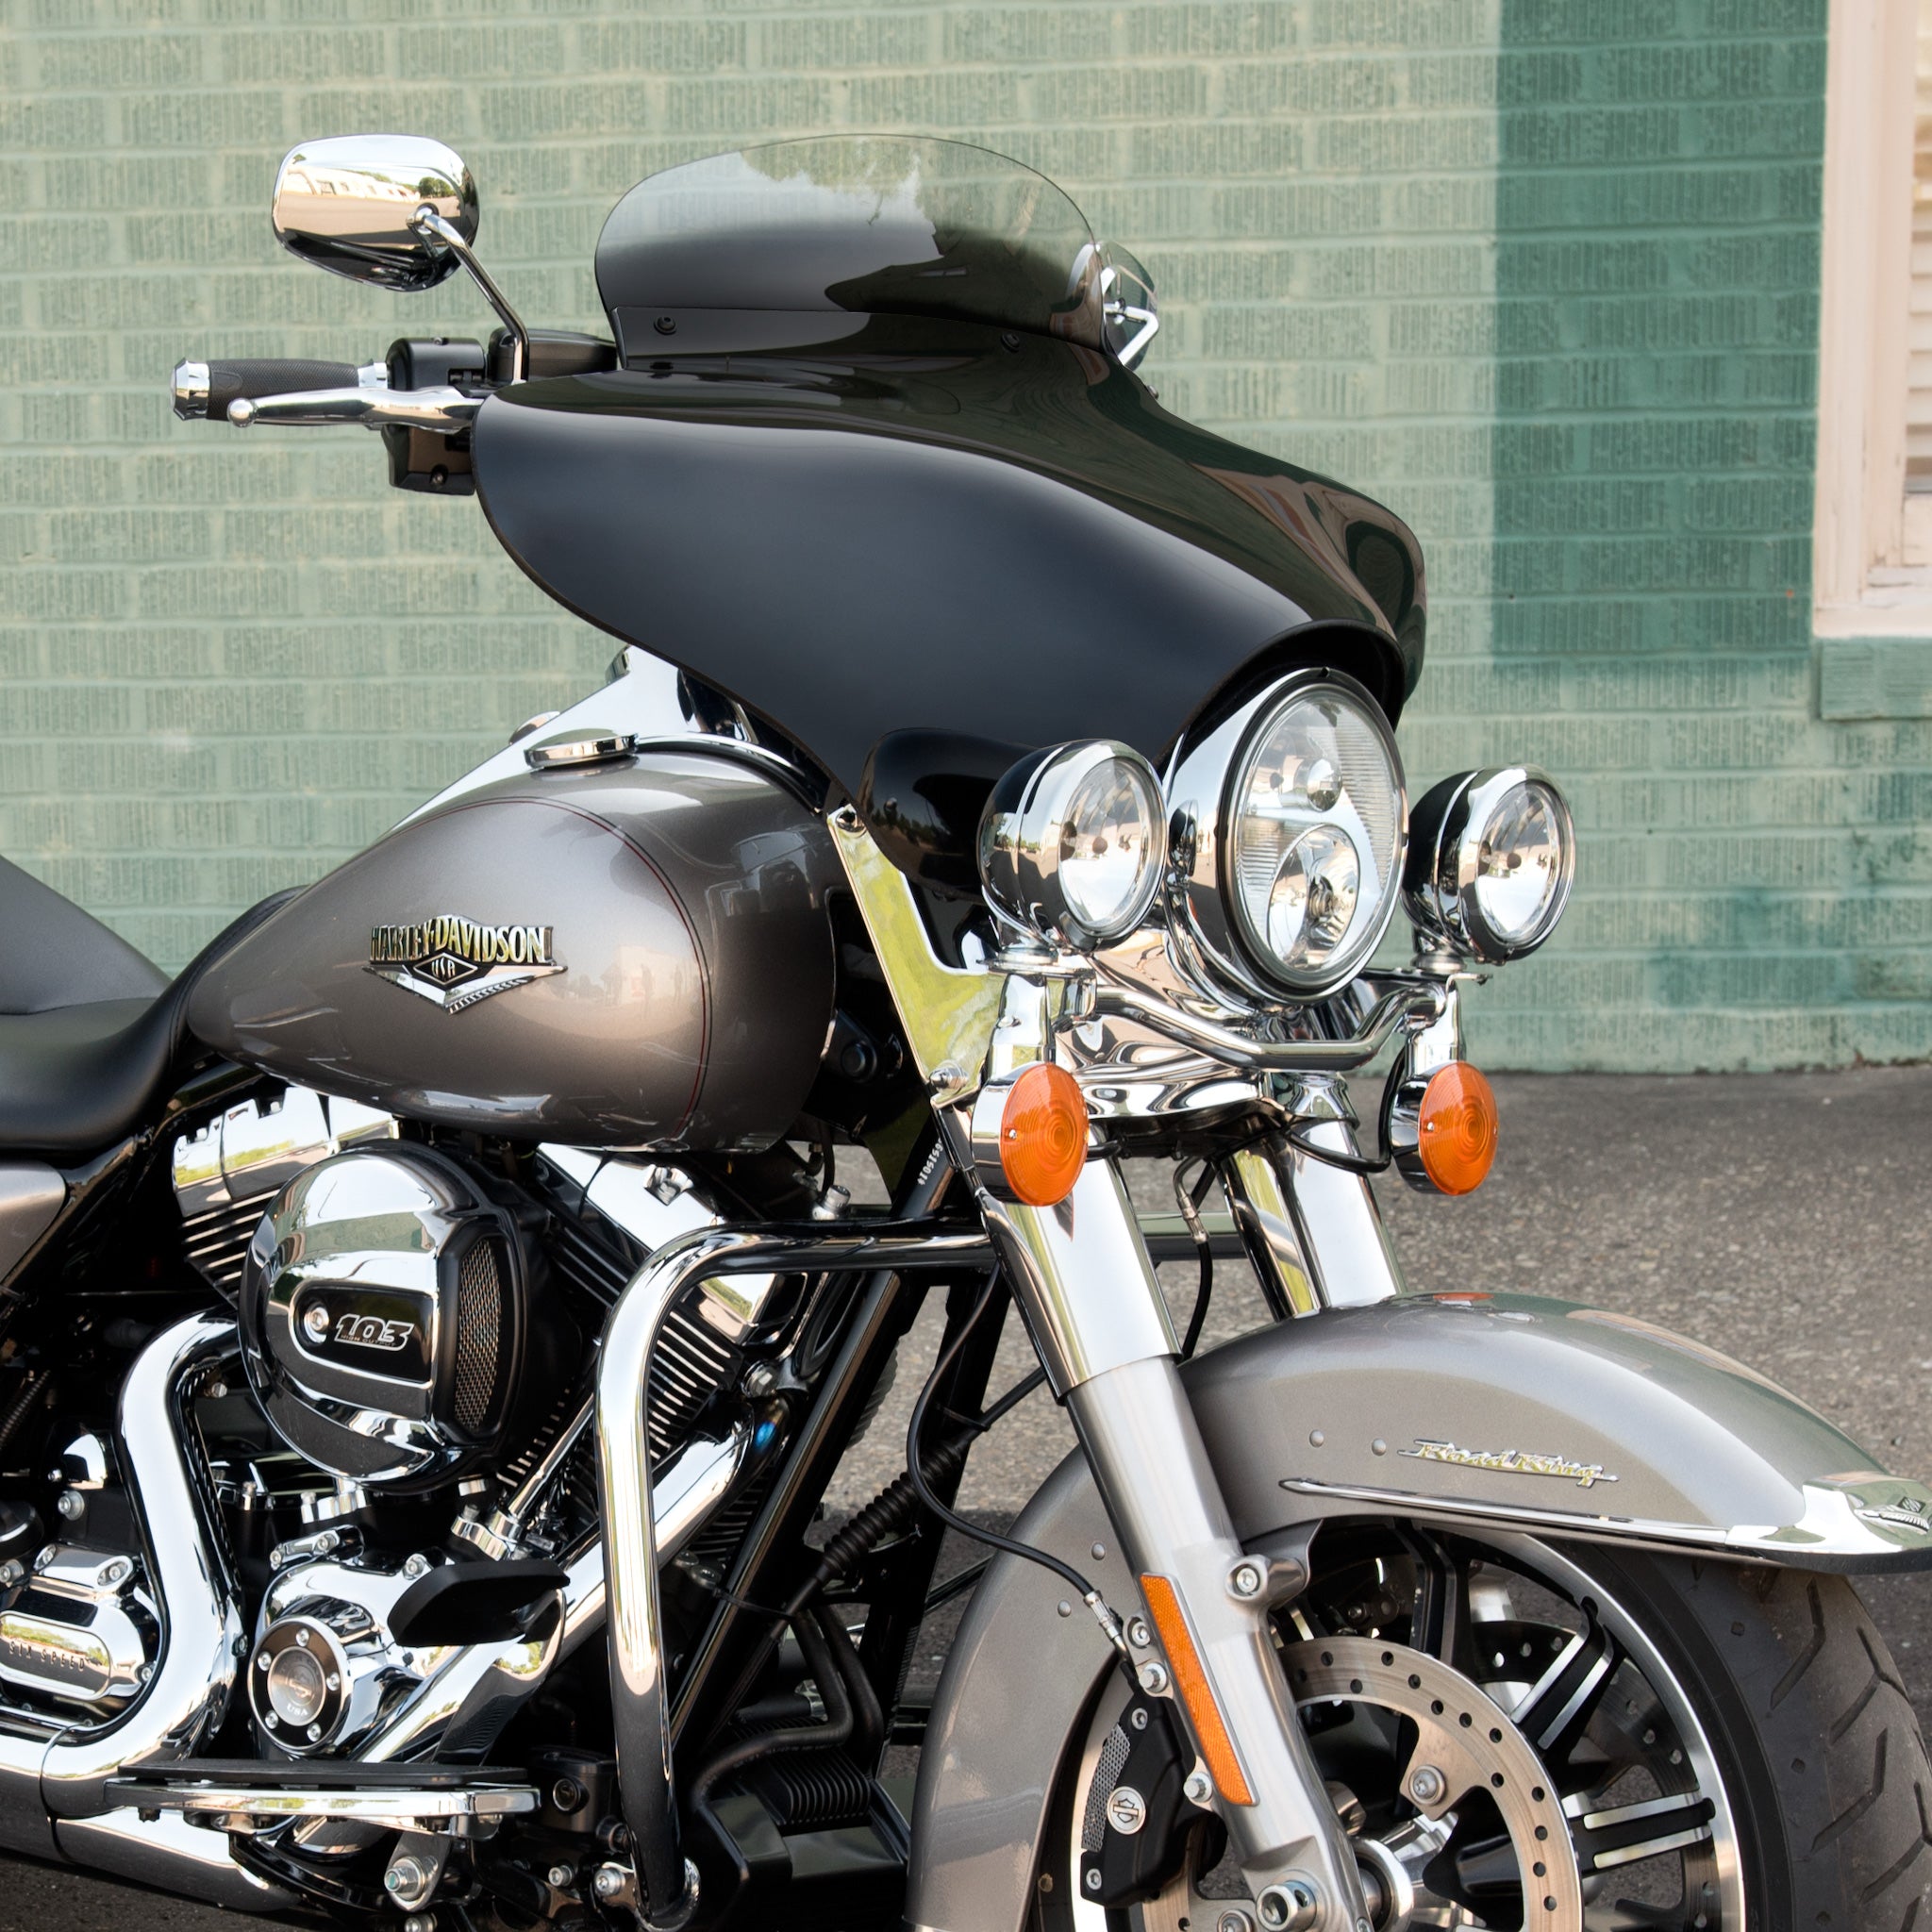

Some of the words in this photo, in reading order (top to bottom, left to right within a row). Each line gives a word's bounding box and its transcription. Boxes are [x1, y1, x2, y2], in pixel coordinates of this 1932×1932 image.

[369, 915, 548, 964] HARLEY-DAVIDSON
[431, 958, 456, 979] USA
[334, 1313, 415, 1352] 103
[1400, 1439, 1516, 1469] Road
[1511, 1451, 1616, 1489] King
[8, 1641, 32, 1659] SIX
[41, 1649, 86, 1672] SPEED
[286, 1703, 308, 1717] USA
